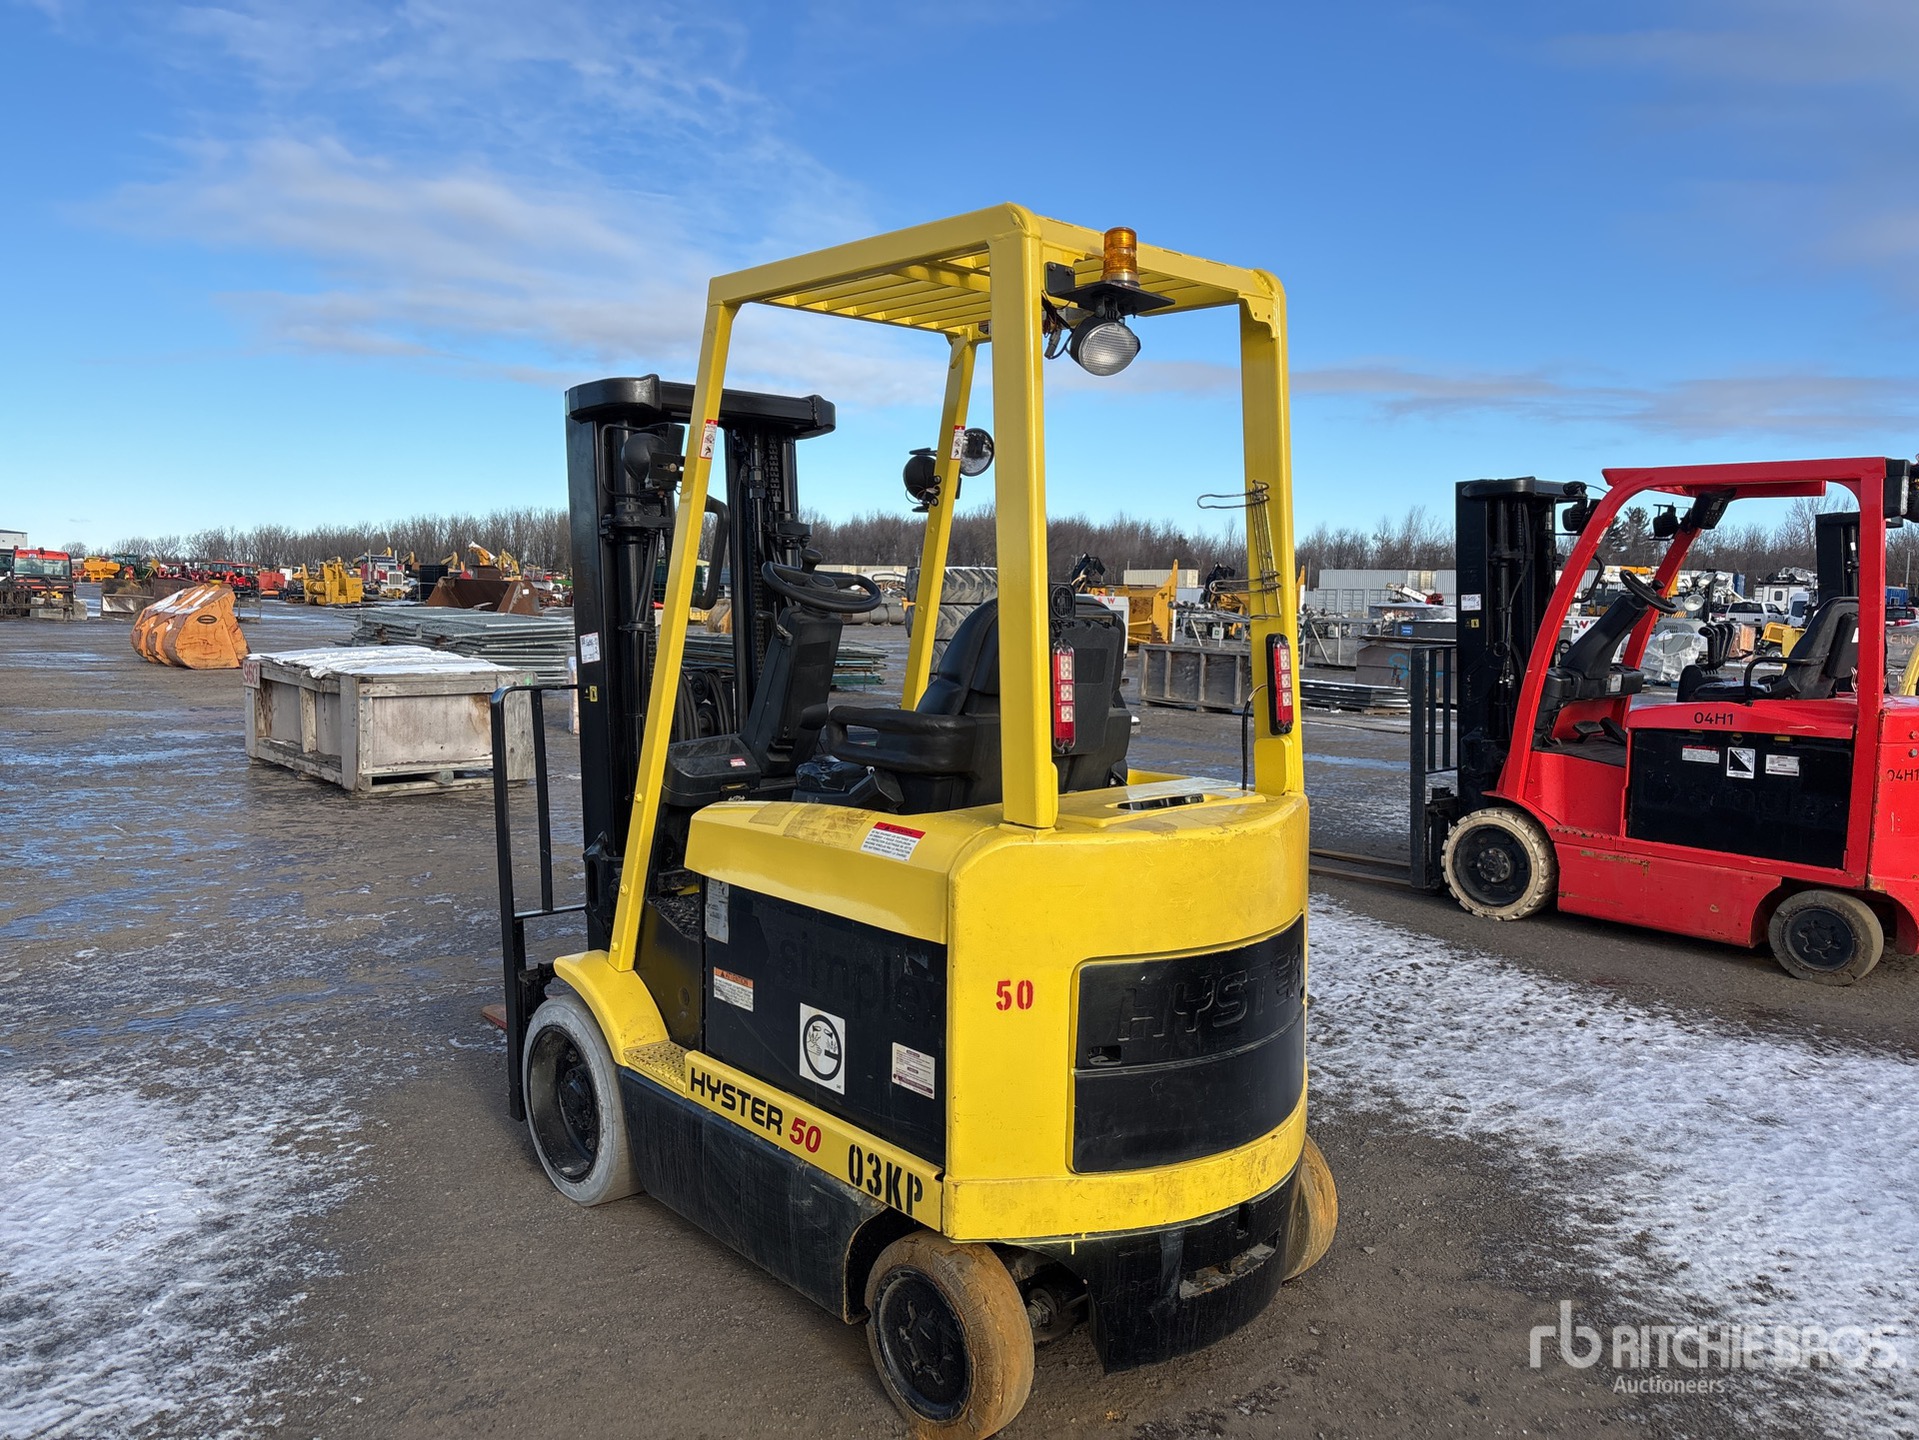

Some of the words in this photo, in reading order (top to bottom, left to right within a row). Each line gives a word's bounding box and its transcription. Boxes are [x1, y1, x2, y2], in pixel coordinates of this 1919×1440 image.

[1694, 711, 1734, 726] 04H1
[996, 979, 1034, 1011] 50
[690, 1067, 783, 1137] HYSTER
[789, 1117, 822, 1154] 50
[848, 1144, 924, 1217] 03KP
